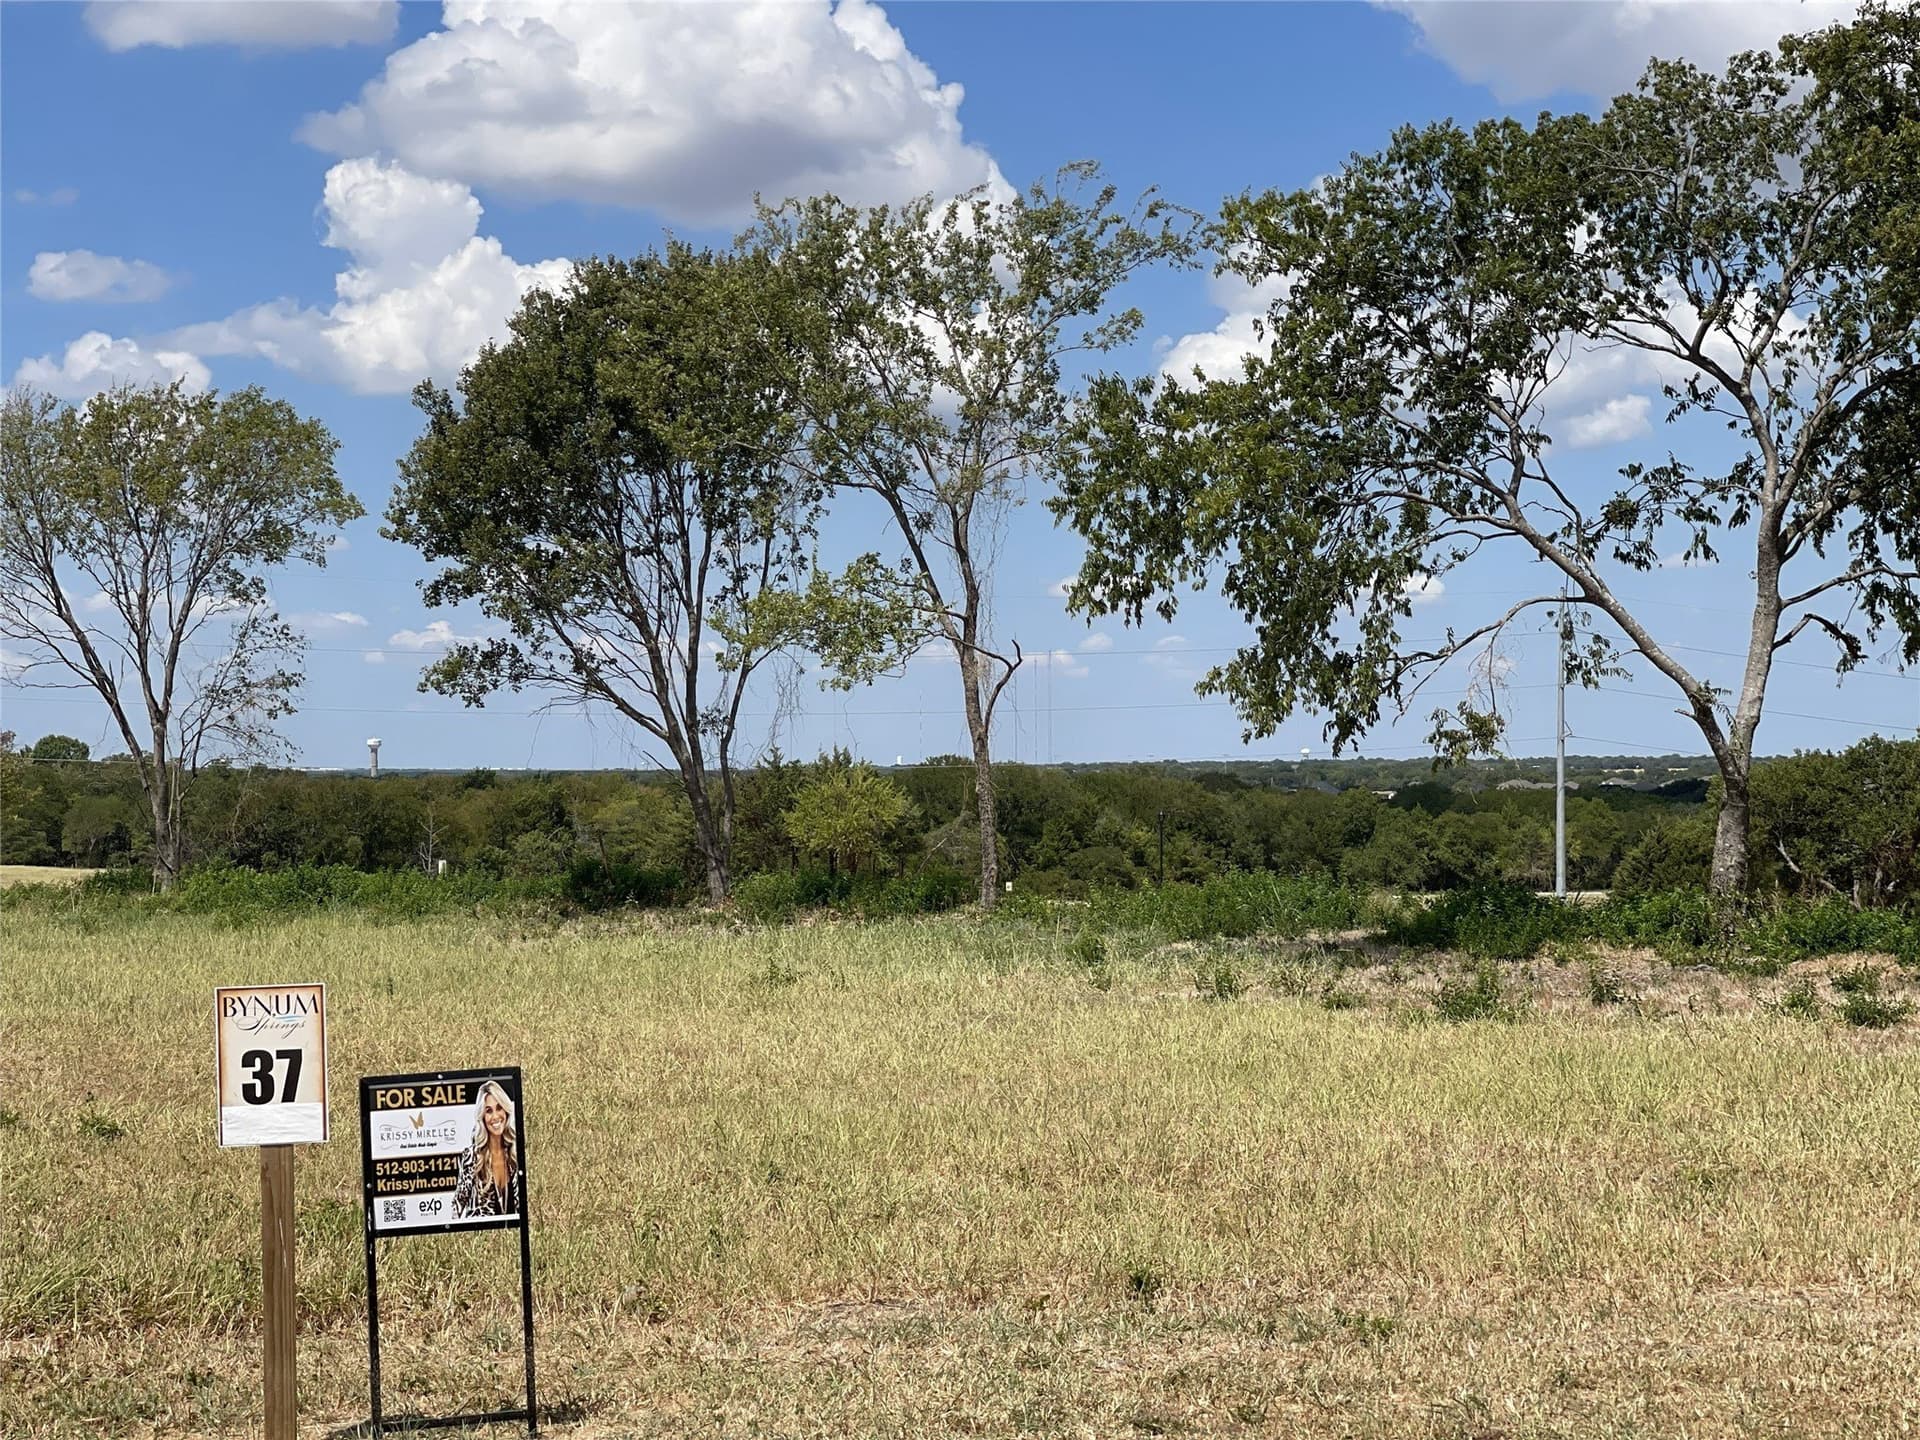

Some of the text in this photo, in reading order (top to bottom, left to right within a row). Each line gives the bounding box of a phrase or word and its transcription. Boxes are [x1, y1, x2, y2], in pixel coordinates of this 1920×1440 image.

[223, 993, 319, 1018] BYNUM
[231, 1009, 306, 1039] Springs
[241, 1049, 303, 1105] 37
[376, 1085, 466, 1109] FOR SALE
[380, 1130, 414, 1142] KRISSY
[416, 1127, 456, 1139] MIRELES
[376, 1157, 458, 1176] 512-903-1121
[377, 1176, 457, 1192] Krissym.com
